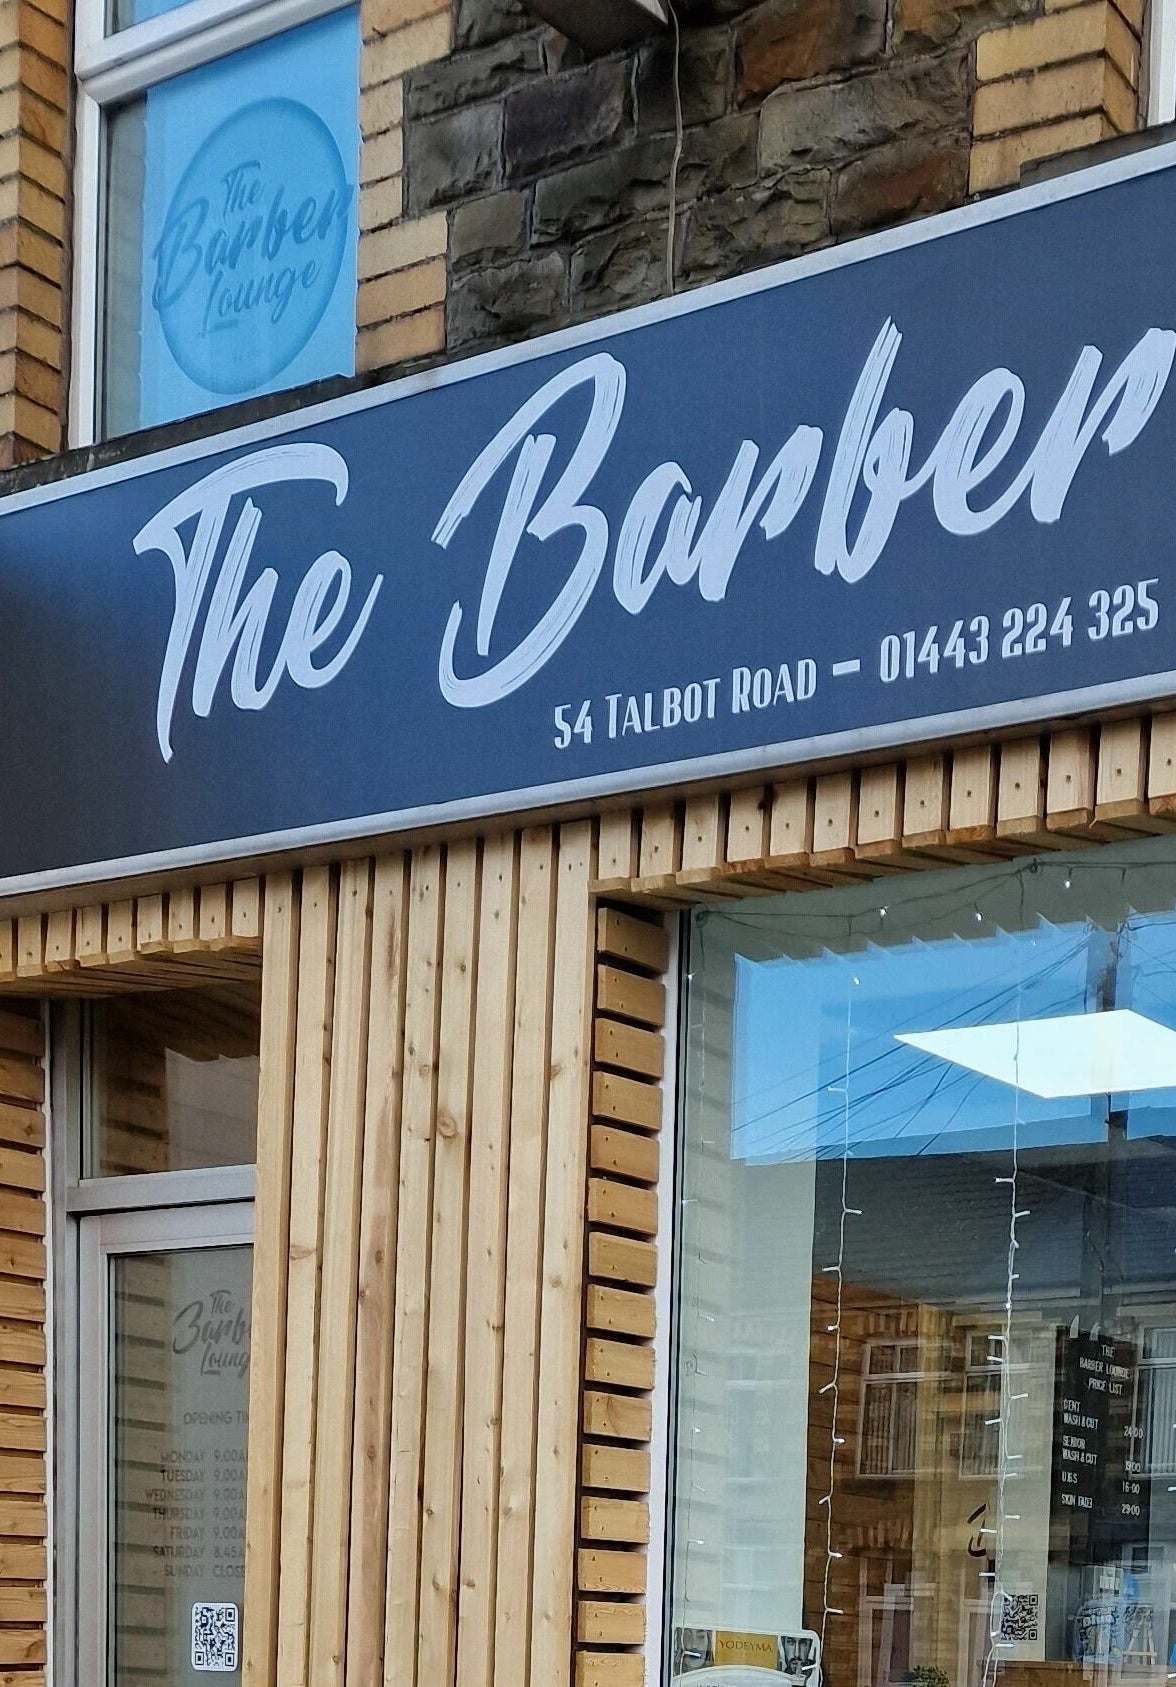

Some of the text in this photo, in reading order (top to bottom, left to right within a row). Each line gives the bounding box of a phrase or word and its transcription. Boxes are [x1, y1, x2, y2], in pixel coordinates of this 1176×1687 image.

[220, 159, 264, 220] The
[152, 184, 354, 311] Barber
[198, 258, 320, 338] Lounge
[133, 441, 384, 765] The
[553, 703, 592, 750] 54
[879, 615, 991, 684] 01443
[1002, 596, 1074, 659] 224
[1087, 578, 1160, 643] 325
[209, 1289, 232, 1318] The
[1101, 1344, 1116, 1358] THE
[201, 1342, 250, 1379] Loung
[1079, 1356, 1104, 1374] BARBER
[1088, 1377, 1124, 1396] PRICE LIST
[183, 1410, 233, 1425] OPENING
[161, 1448, 248, 1463] MONDAY 9.00A
[161, 1468, 246, 1482] TUESDAY 9.00A
[145, 1487, 246, 1501] WEDNESDAY 9.00A
[153, 1506, 245, 1520] THURSDAY 9.00A
[170, 1526, 245, 1540] FRIDAY 9.00A
[153, 1545, 205, 1559] SATURDAY
[164, 1564, 246, 1578] SUNDAY CLOSE
[718, 1638, 773, 1652] YODEYMA
